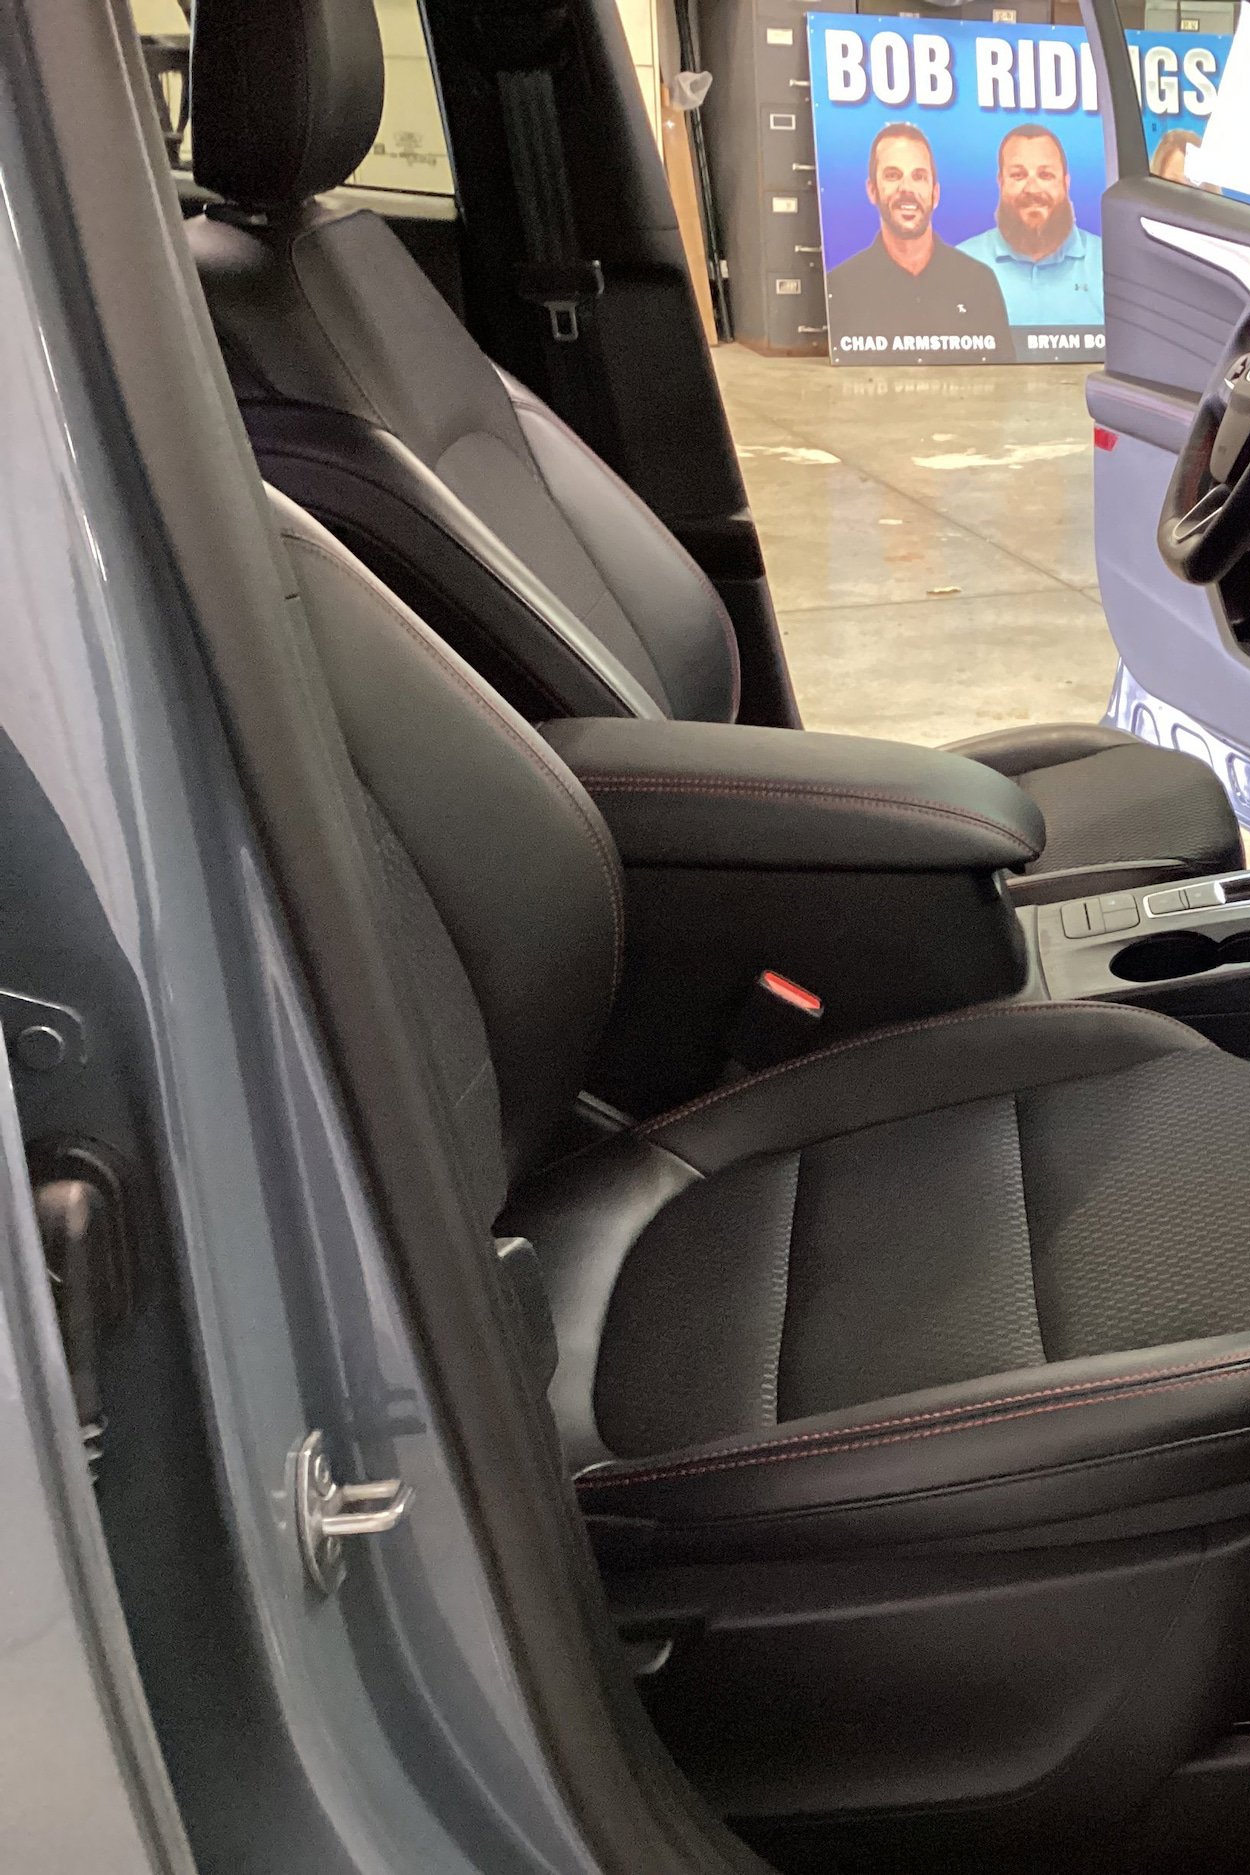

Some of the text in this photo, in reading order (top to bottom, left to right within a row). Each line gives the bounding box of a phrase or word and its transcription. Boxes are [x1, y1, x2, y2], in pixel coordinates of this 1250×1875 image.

[825, 29, 1218, 116] BOB RIDIGS
[840, 334, 996, 350] CHAD ARMSTRONG
[1027, 334, 1080, 349] BRYAN
